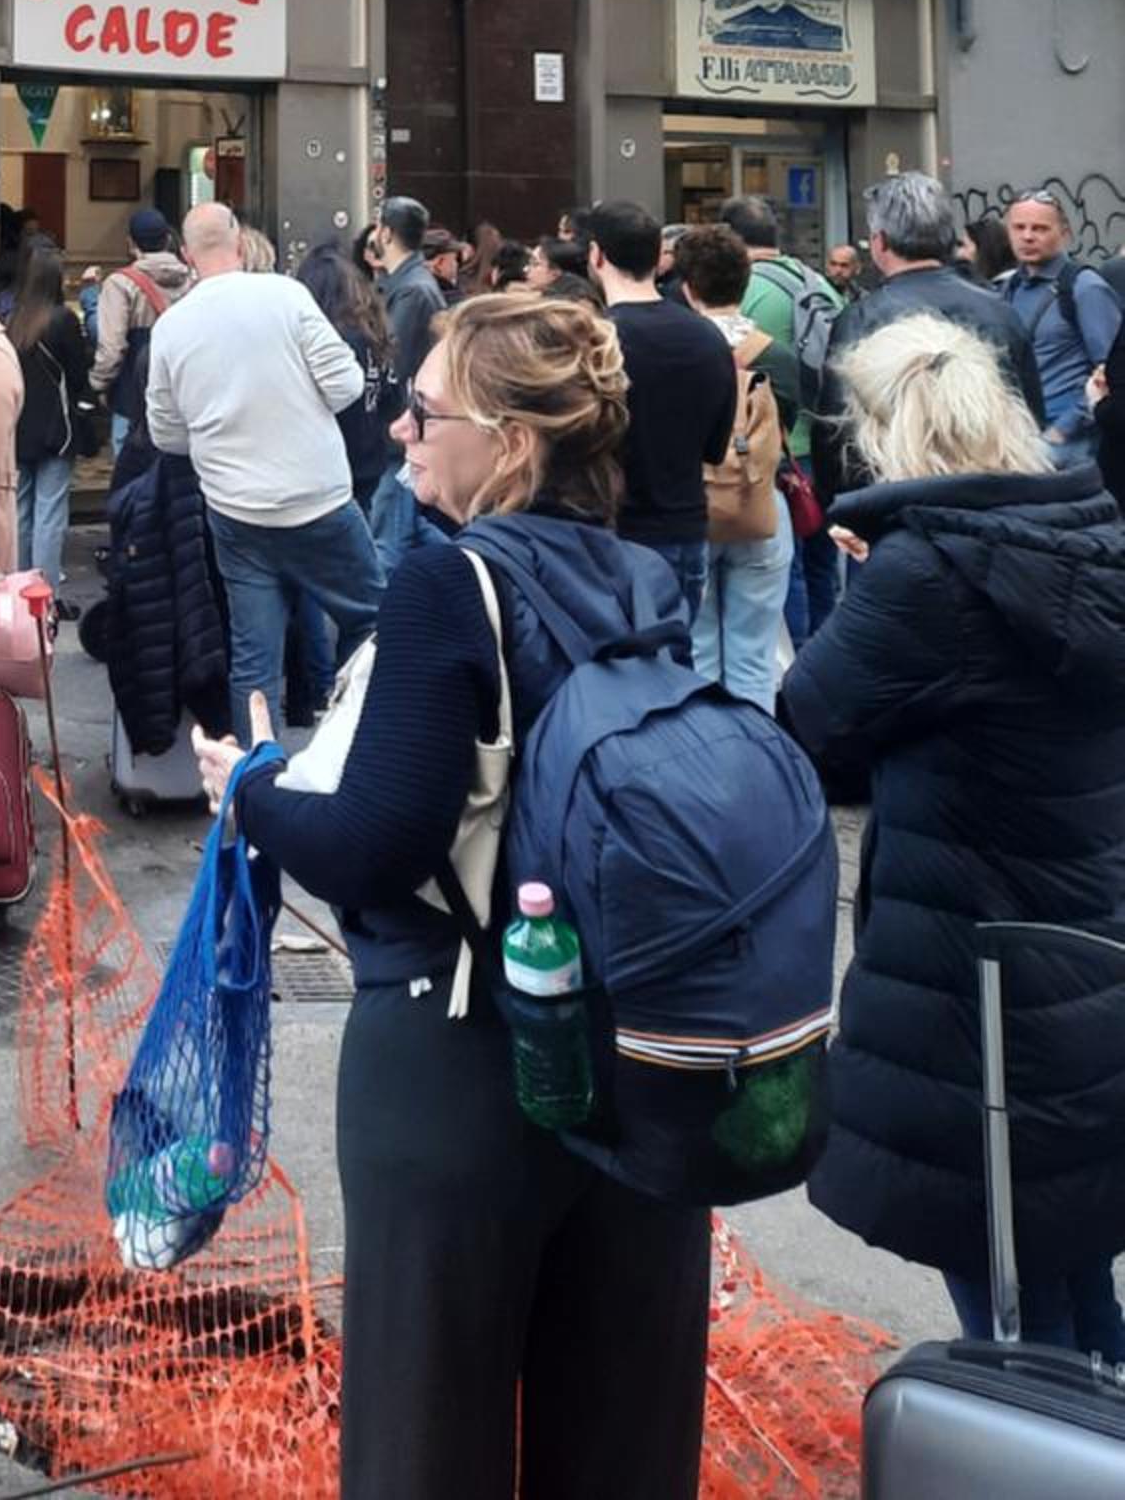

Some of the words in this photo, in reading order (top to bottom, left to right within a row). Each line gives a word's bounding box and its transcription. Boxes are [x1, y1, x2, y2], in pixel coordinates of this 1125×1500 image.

[65, 4, 237, 58] CALDE
[702, 56, 740, 81] F.lli
[743, 59, 853, 87] ATTANASIO
